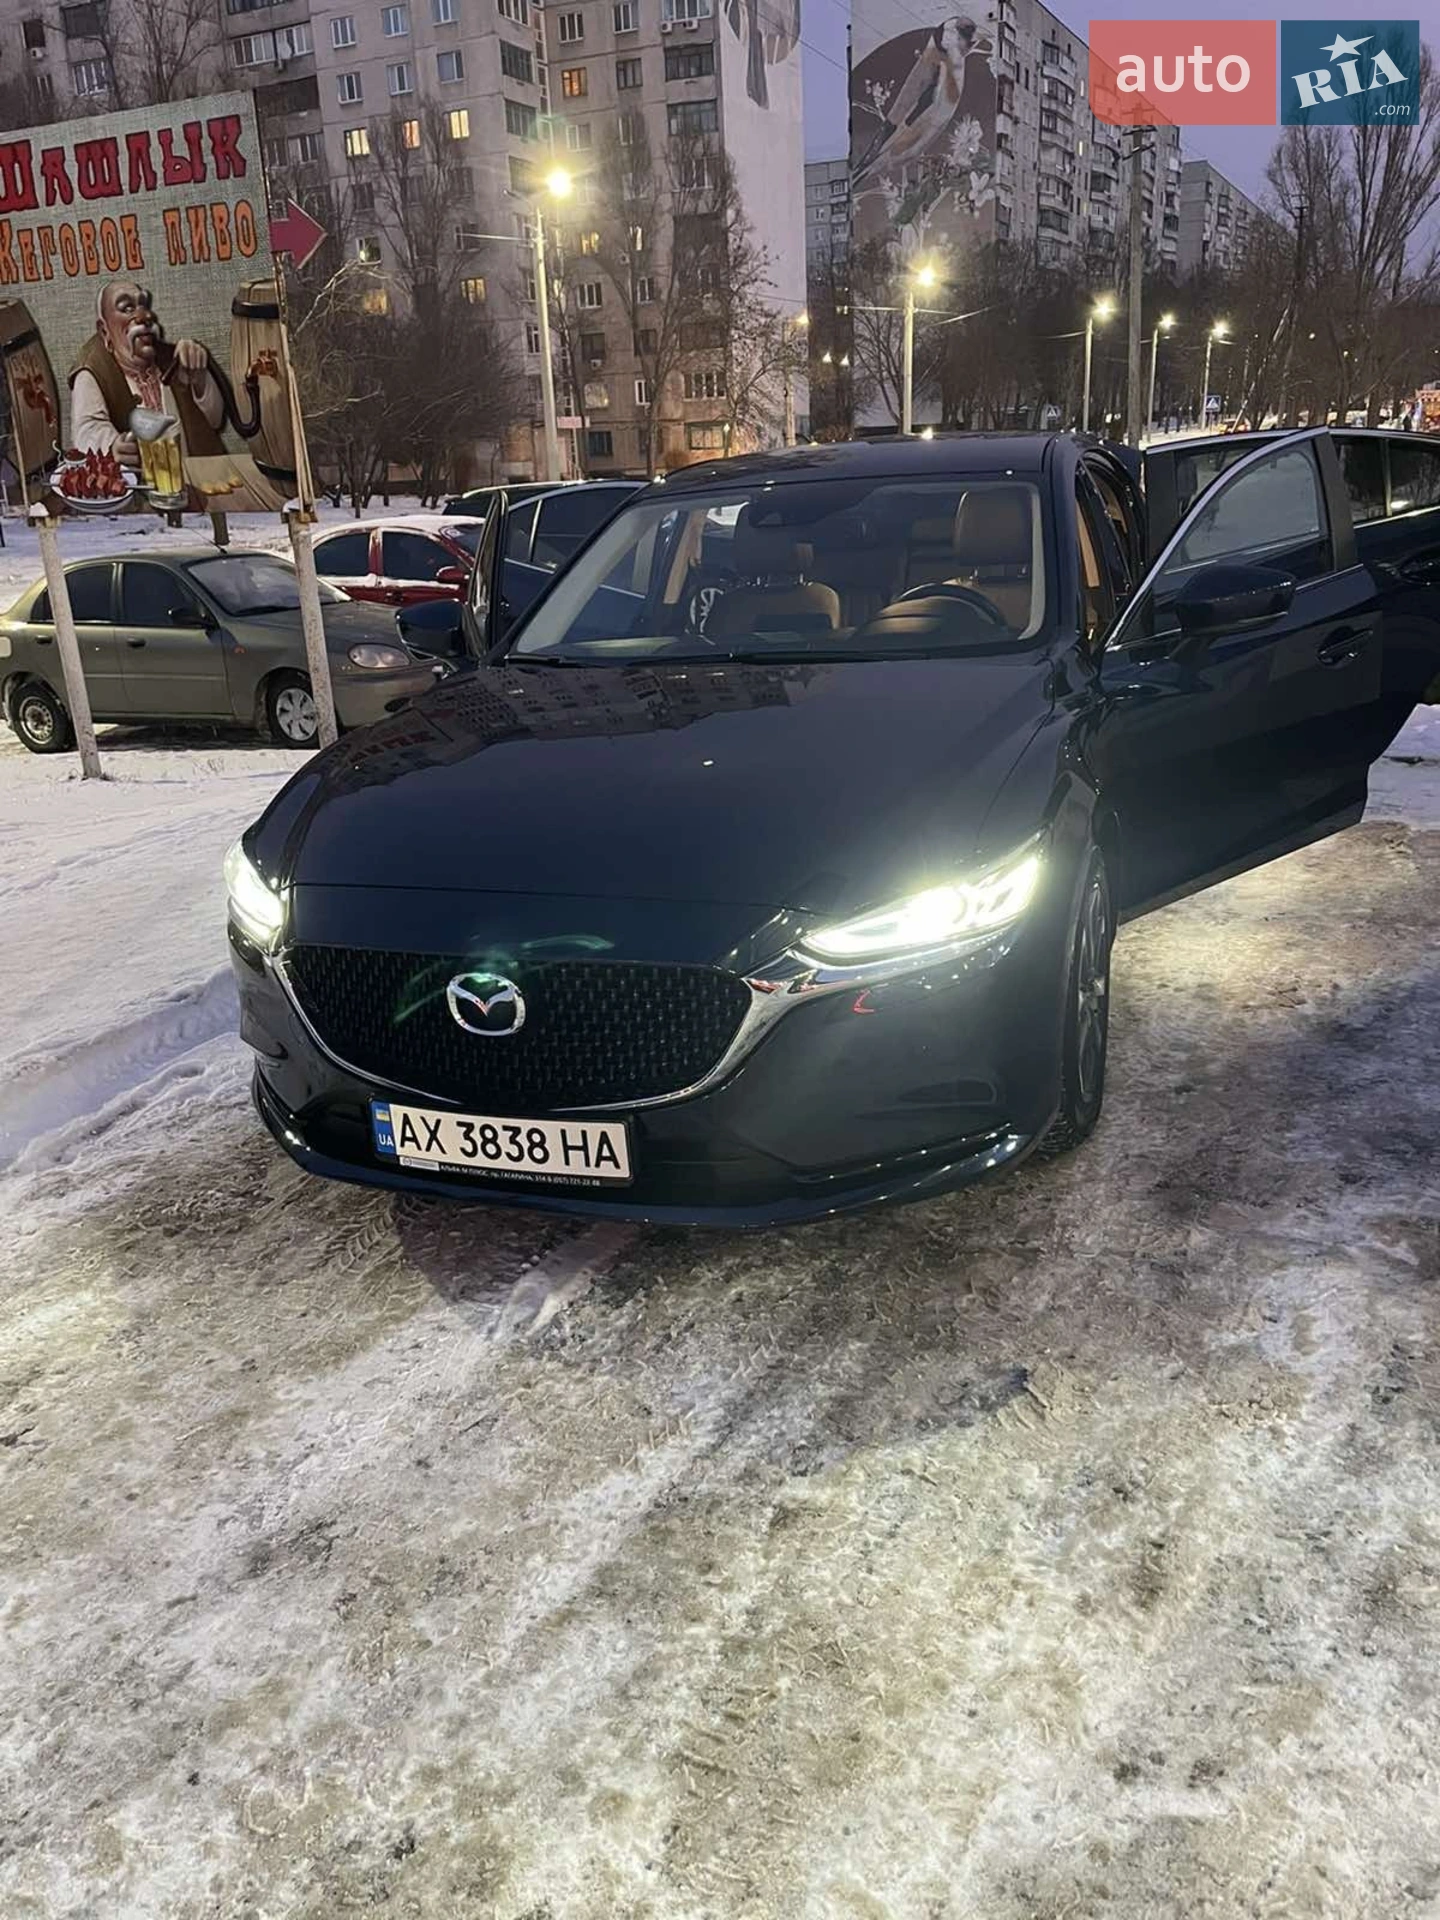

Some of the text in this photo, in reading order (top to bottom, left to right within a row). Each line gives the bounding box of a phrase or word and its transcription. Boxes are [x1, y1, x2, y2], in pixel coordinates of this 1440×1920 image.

[0, 114, 247, 214] ШАШЛЫК
[162, 199, 258, 266] ПИВО
[378, 1133, 395, 1147] UA
[400, 1113, 621, 1170] AX 3838 HA
